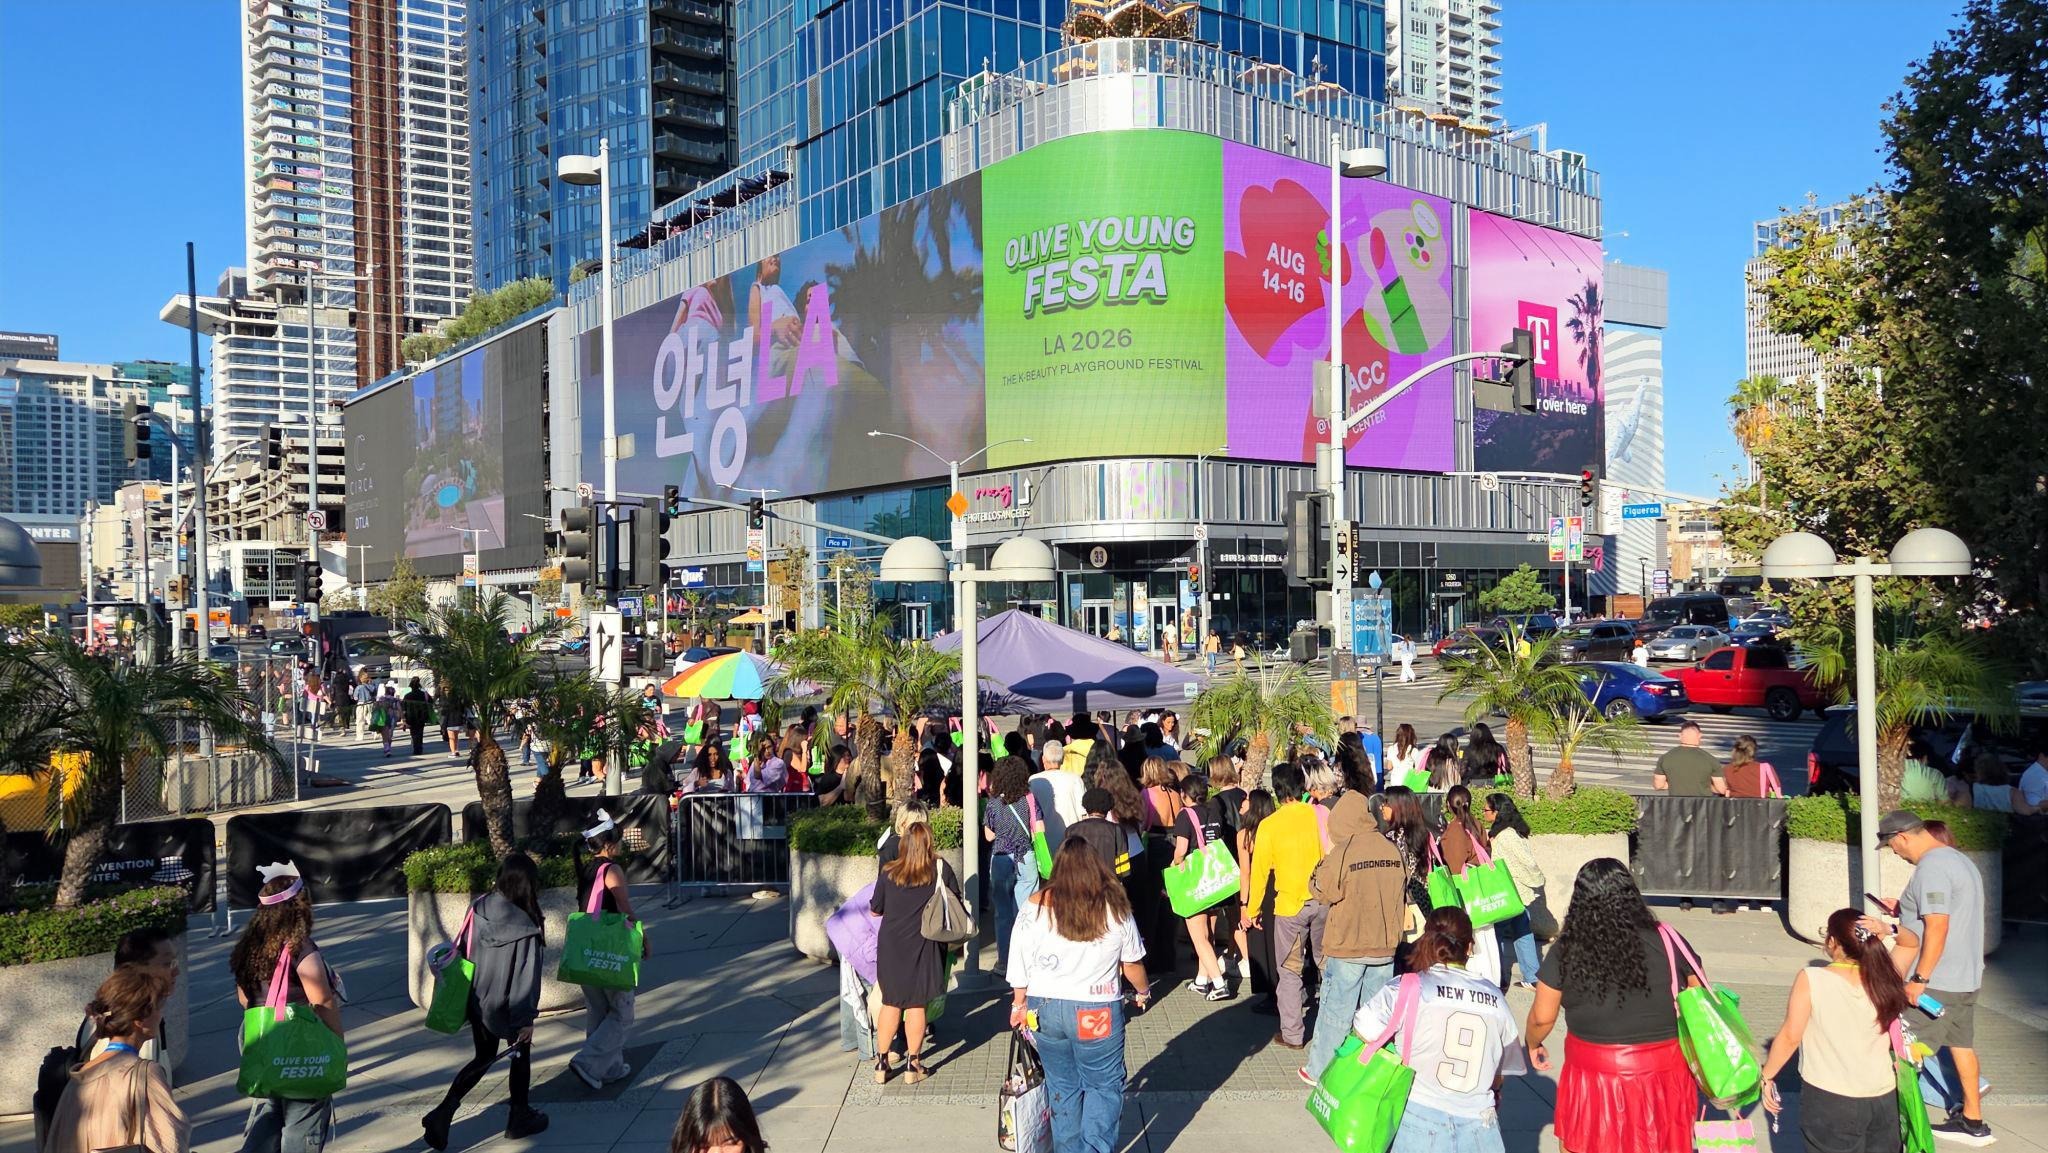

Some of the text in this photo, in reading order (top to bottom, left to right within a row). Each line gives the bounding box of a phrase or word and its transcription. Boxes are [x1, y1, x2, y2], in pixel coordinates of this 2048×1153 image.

[1004, 215, 1196, 270] OLIVE YOUNG
[1266, 242, 1305, 275] AUG
[1023, 253, 1169, 316] FESTA
[1262, 268, 1305, 303] 14-16
[757, 282, 839, 404] LA
[1043, 327, 1132, 356] LA 2026
[1002, 358, 1204, 387] THE K-BEAUTY PLAYGROUND FESTIVAL
[1349, 360, 1386, 393] ACC
[1352, 409, 1387, 434] CENTER
[1542, 399, 1564, 412] over
[1565, 398, 1588, 416] here
[349, 477, 374, 496] CIRCA
[1000, 507, 1031, 520] ANGELES
[1623, 506, 1660, 517] Figueroa
[828, 539, 841, 547] Pico
[1351, 529, 1360, 582] Metro Rail
[587, 957, 622, 972] FESTA
[1436, 985, 1499, 1009] NEW YORK
[272, 1055, 332, 1066] OLIVE YOUNG
[1435, 1010, 1488, 1095] 9
[279, 1066, 325, 1080] FESTA
[1312, 1092, 1331, 1122] FESTA
